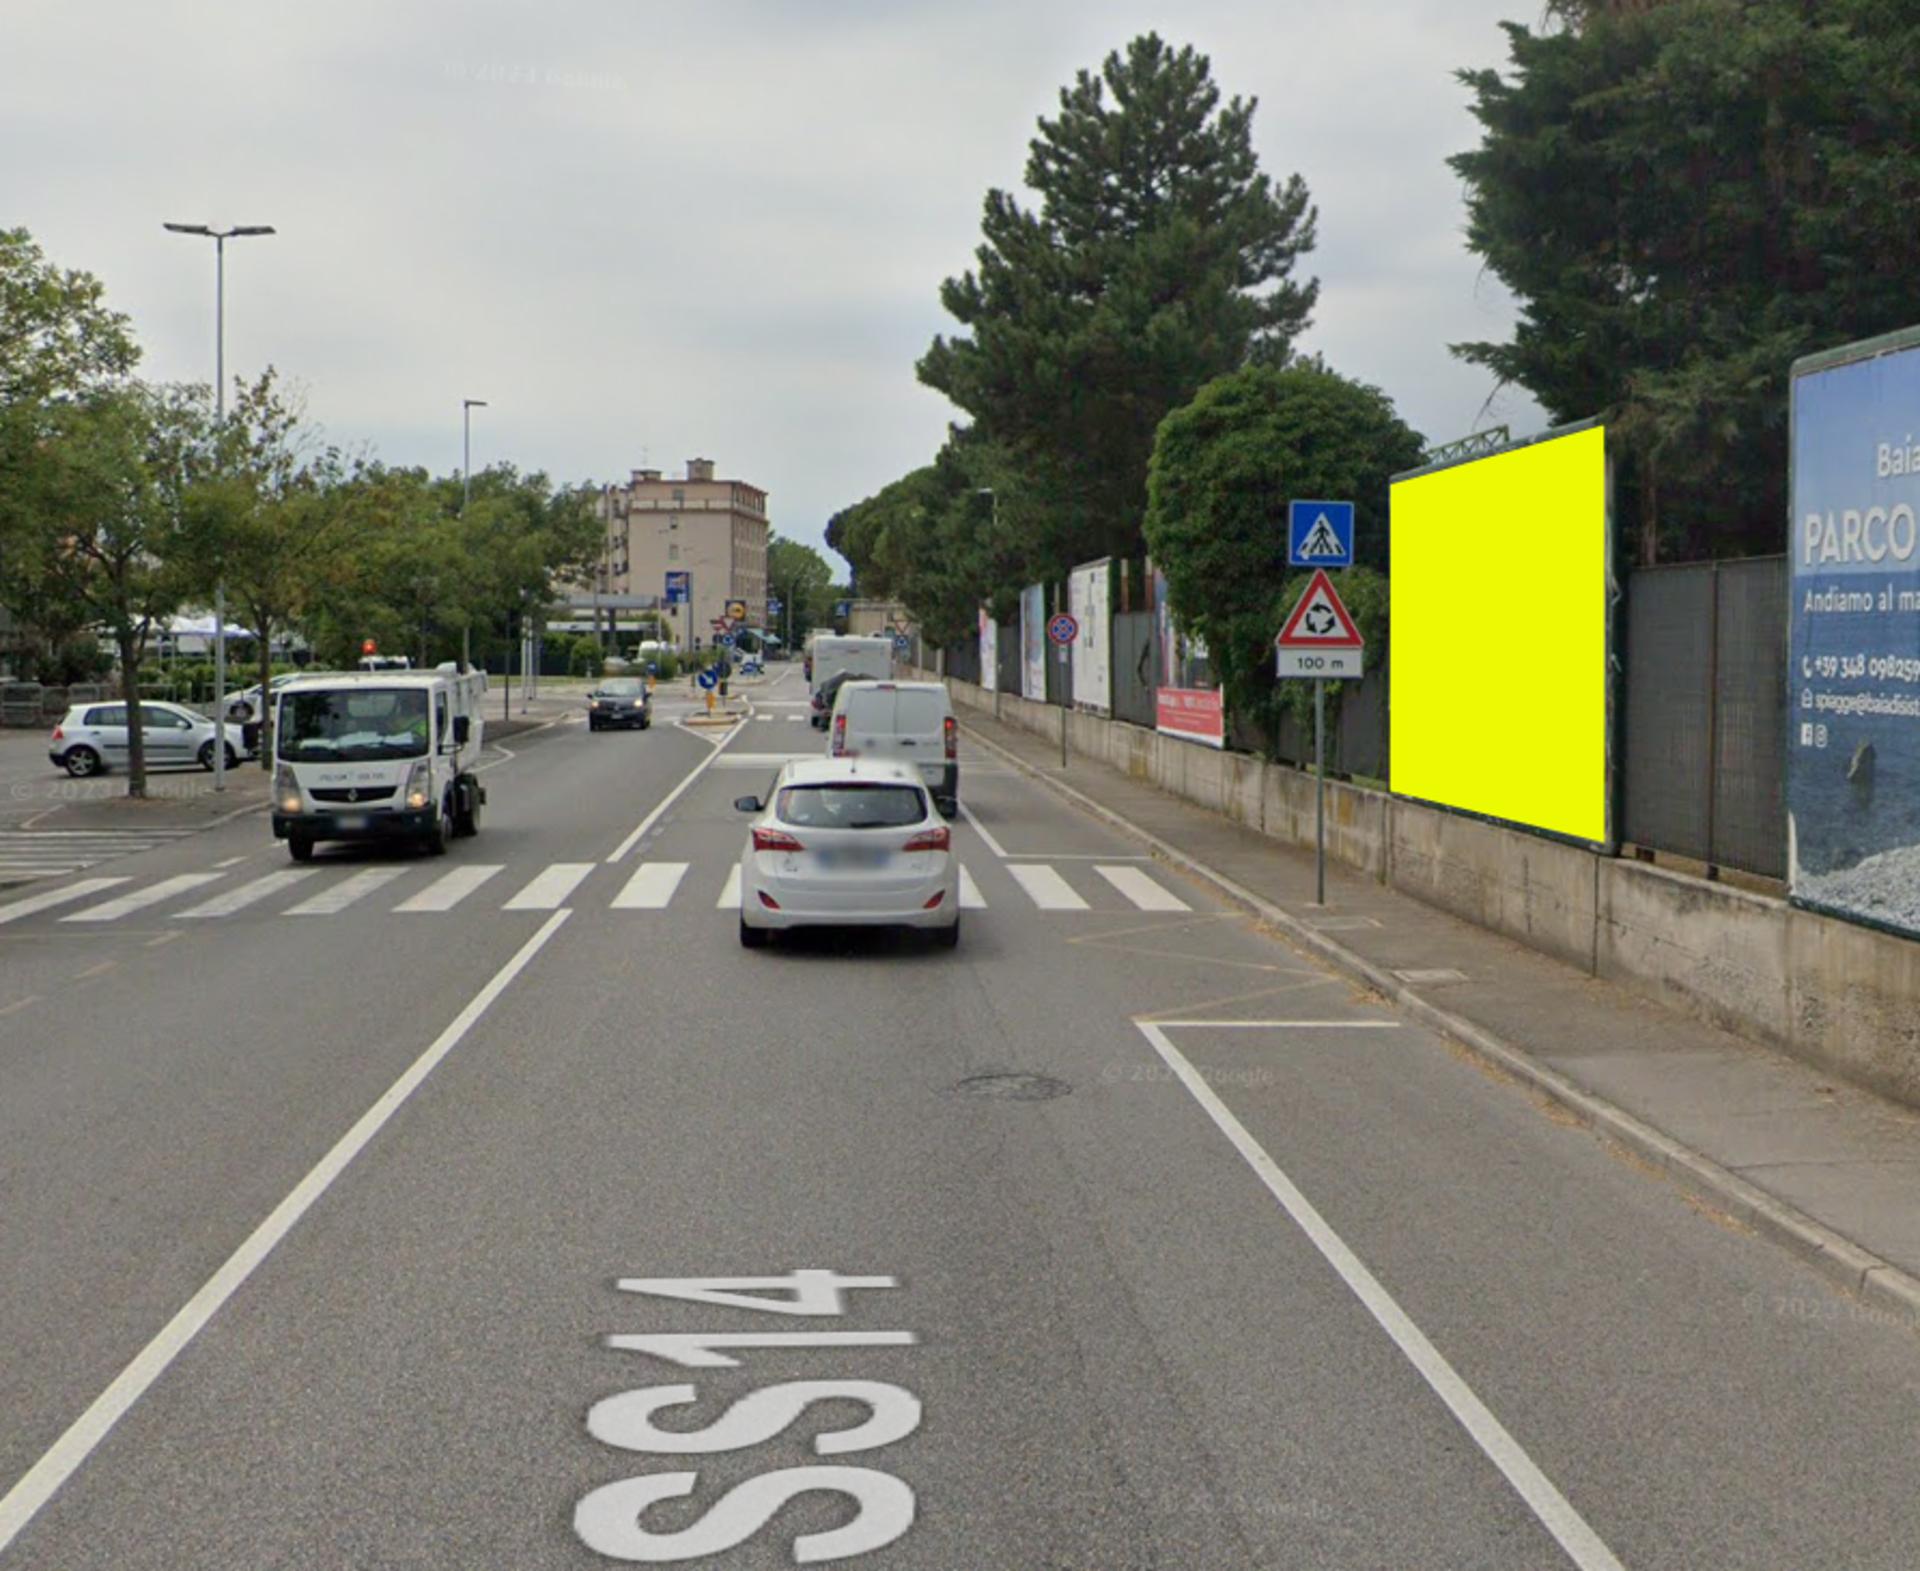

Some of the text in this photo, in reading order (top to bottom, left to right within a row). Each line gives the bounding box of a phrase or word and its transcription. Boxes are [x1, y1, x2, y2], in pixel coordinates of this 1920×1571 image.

[1804, 503, 1916, 564] PARCO
[1803, 588, 1874, 612] Andiamo
[1878, 583, 1893, 611] al
[1297, 657, 1344, 670] 100 m
[573, 1269, 922, 1563] SS14
